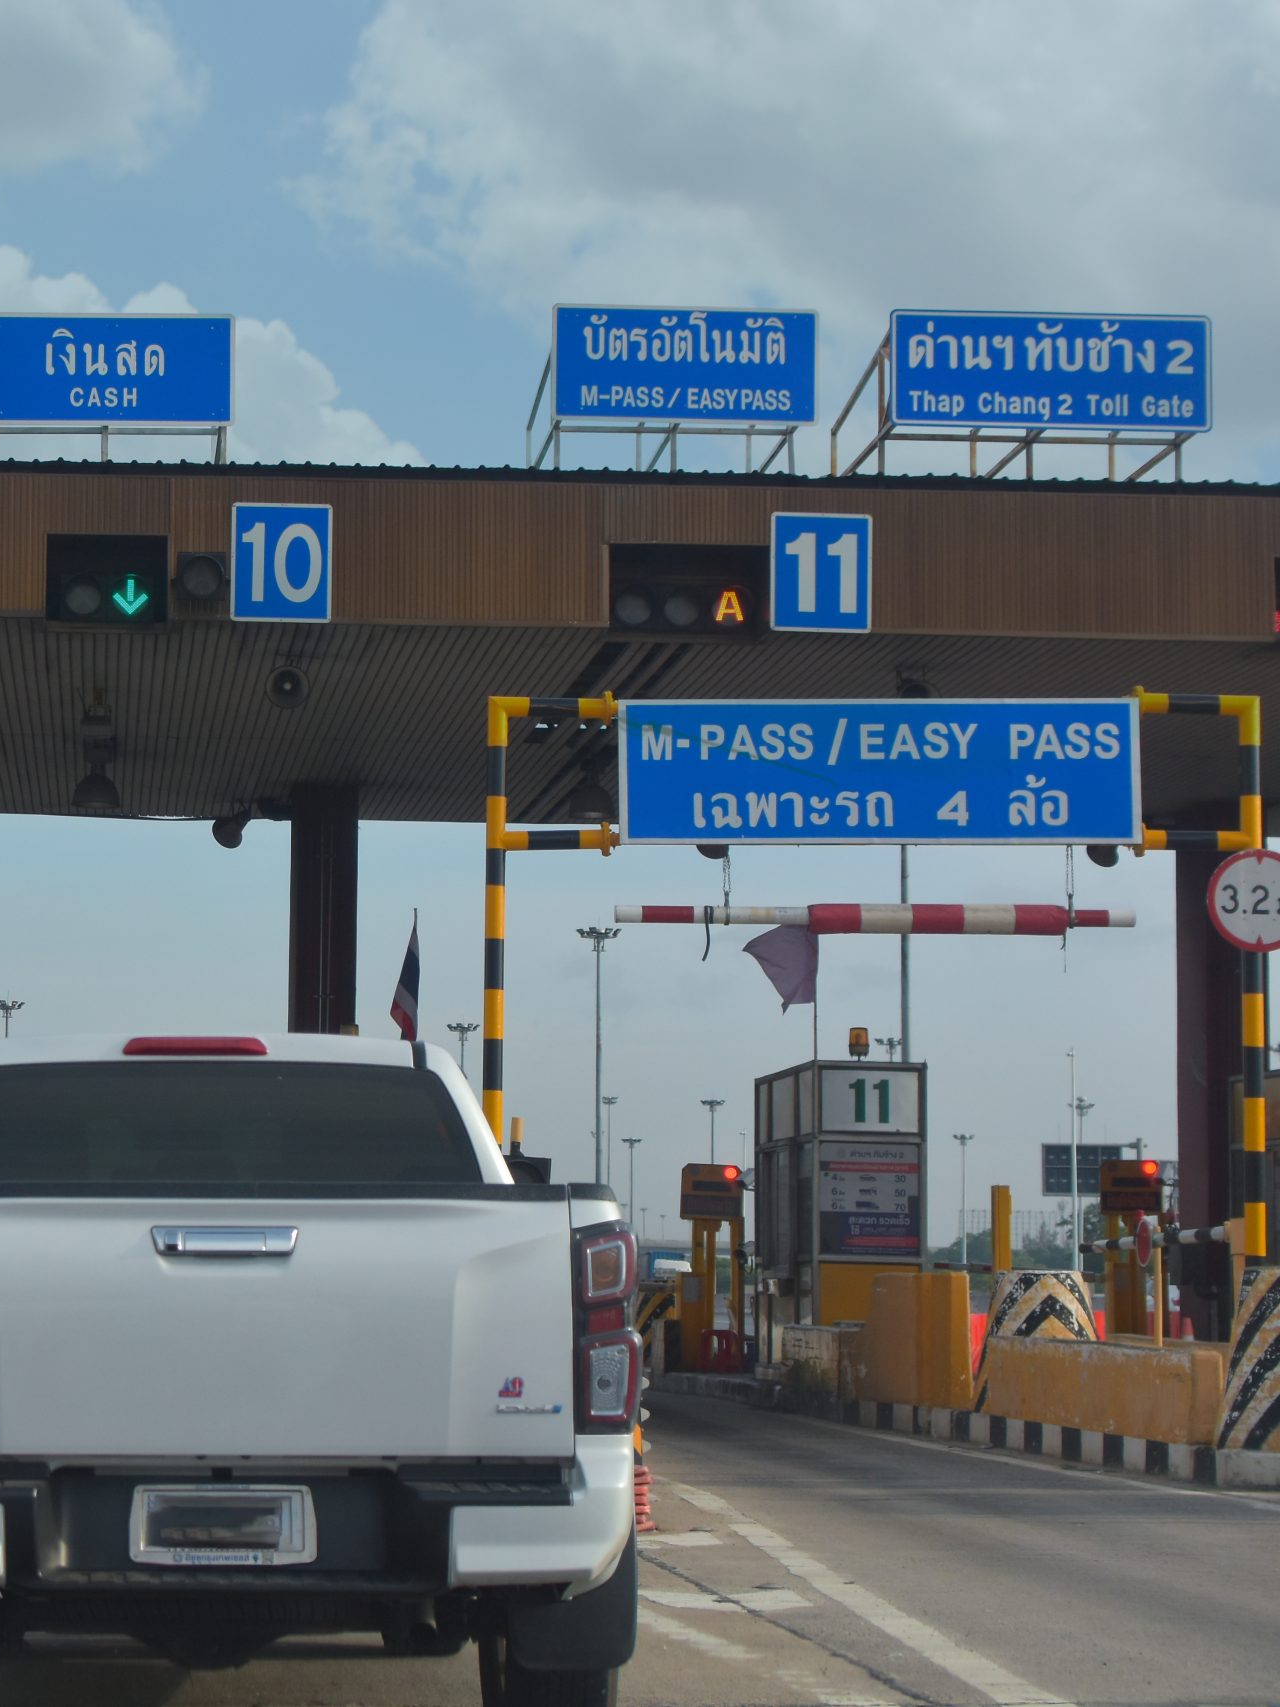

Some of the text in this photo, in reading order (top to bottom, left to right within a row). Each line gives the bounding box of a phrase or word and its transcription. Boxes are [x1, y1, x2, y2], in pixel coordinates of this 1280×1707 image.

[45, 328, 165, 376] เงินสด
[583, 311, 786, 364] บัตรอัตโนมัติ
[909, 320, 1194, 375] ด่านฯ ทับช้าง 2
[69, 387, 137, 407] CASH
[909, 391, 1195, 421] Thap Chang 2 Toll Gate
[242, 522, 322, 603] 10
[786, 532, 858, 613] 11
[715, 591, 744, 622] A
[1010, 722, 1120, 760] PASS
[694, 774, 1068, 829] เฉพาะรถ 4 ล้อ
[1221, 884, 1280, 915] 3.2
[848, 1078, 890, 1124] 11
[894, 1174, 906, 1183] 30
[894, 1203, 906, 1212] 70
